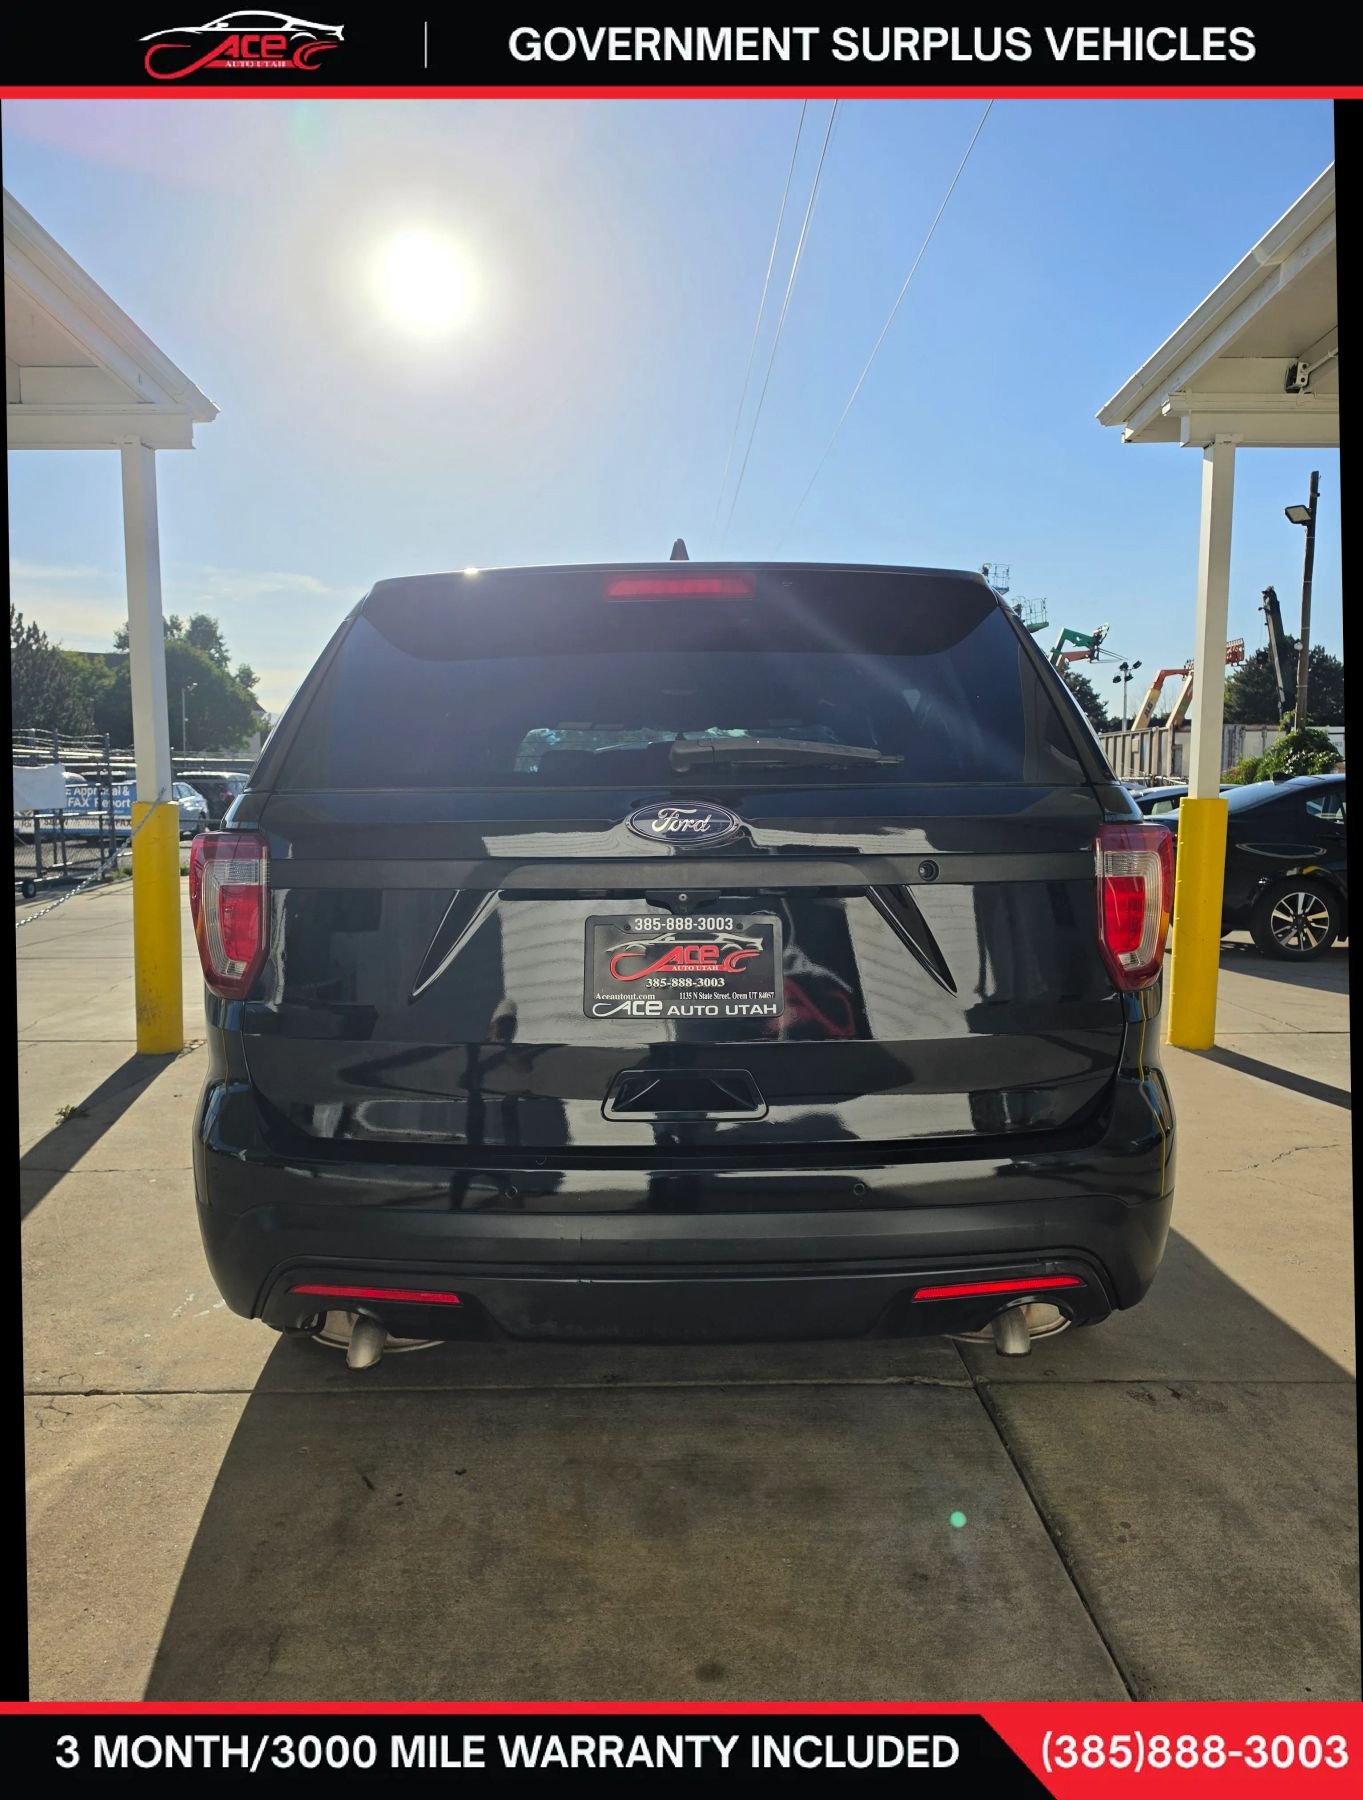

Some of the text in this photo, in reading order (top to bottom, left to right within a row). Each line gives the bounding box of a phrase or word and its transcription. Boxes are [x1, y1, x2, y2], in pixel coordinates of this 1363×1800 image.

[651, 807, 712, 832] Ford
[634, 917, 734, 931] 385-888-3003
[645, 977, 726, 988] 385-888-3003
[693, 991, 698, 1000] N
[699, 991, 712, 1000] State
[731, 991, 748, 1000] Orem
[748, 991, 758, 1000] UT
[592, 1000, 777, 1017] ACE AUTO UTAH
